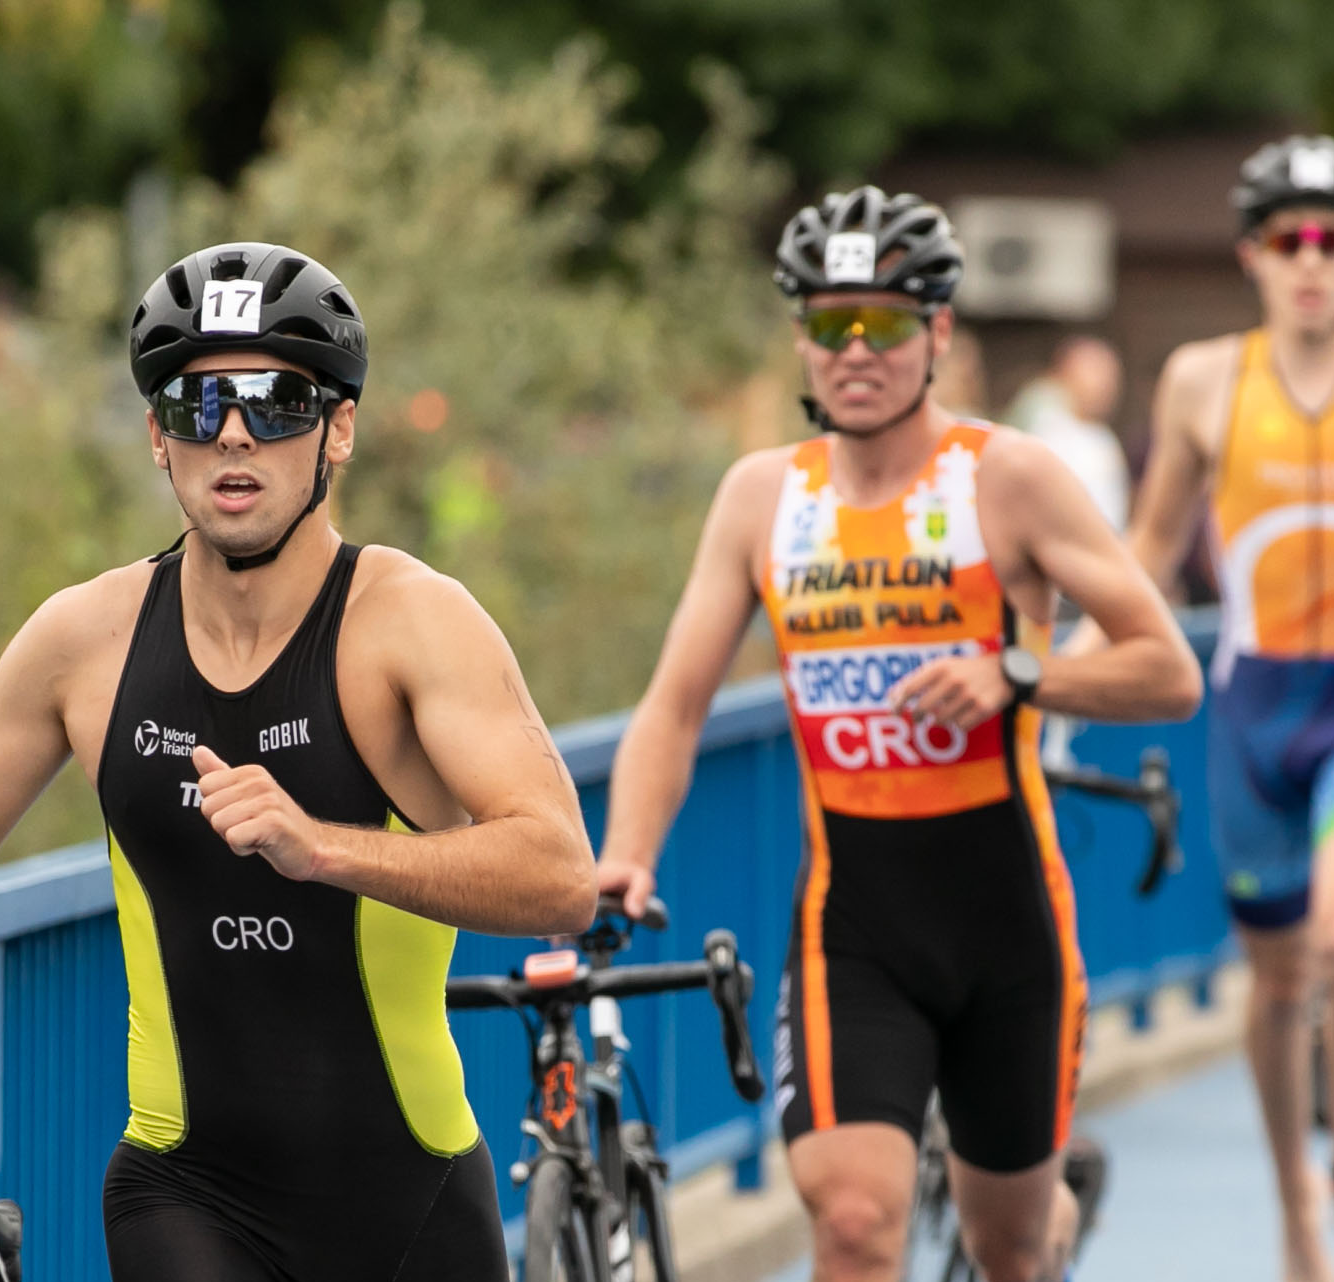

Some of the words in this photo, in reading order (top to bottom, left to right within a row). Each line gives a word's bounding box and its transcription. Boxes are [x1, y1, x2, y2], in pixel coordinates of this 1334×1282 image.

[208, 289, 256, 318] 17
[786, 556, 954, 597] TRIATLON
[786, 603, 864, 634] KLUB
[875, 600, 964, 630] PULA
[161, 740, 195, 757] Triath
[163, 726, 196, 745] World
[259, 718, 310, 752] GOBIK
[822, 715, 967, 770] CRO
[212, 915, 294, 951] CRO
